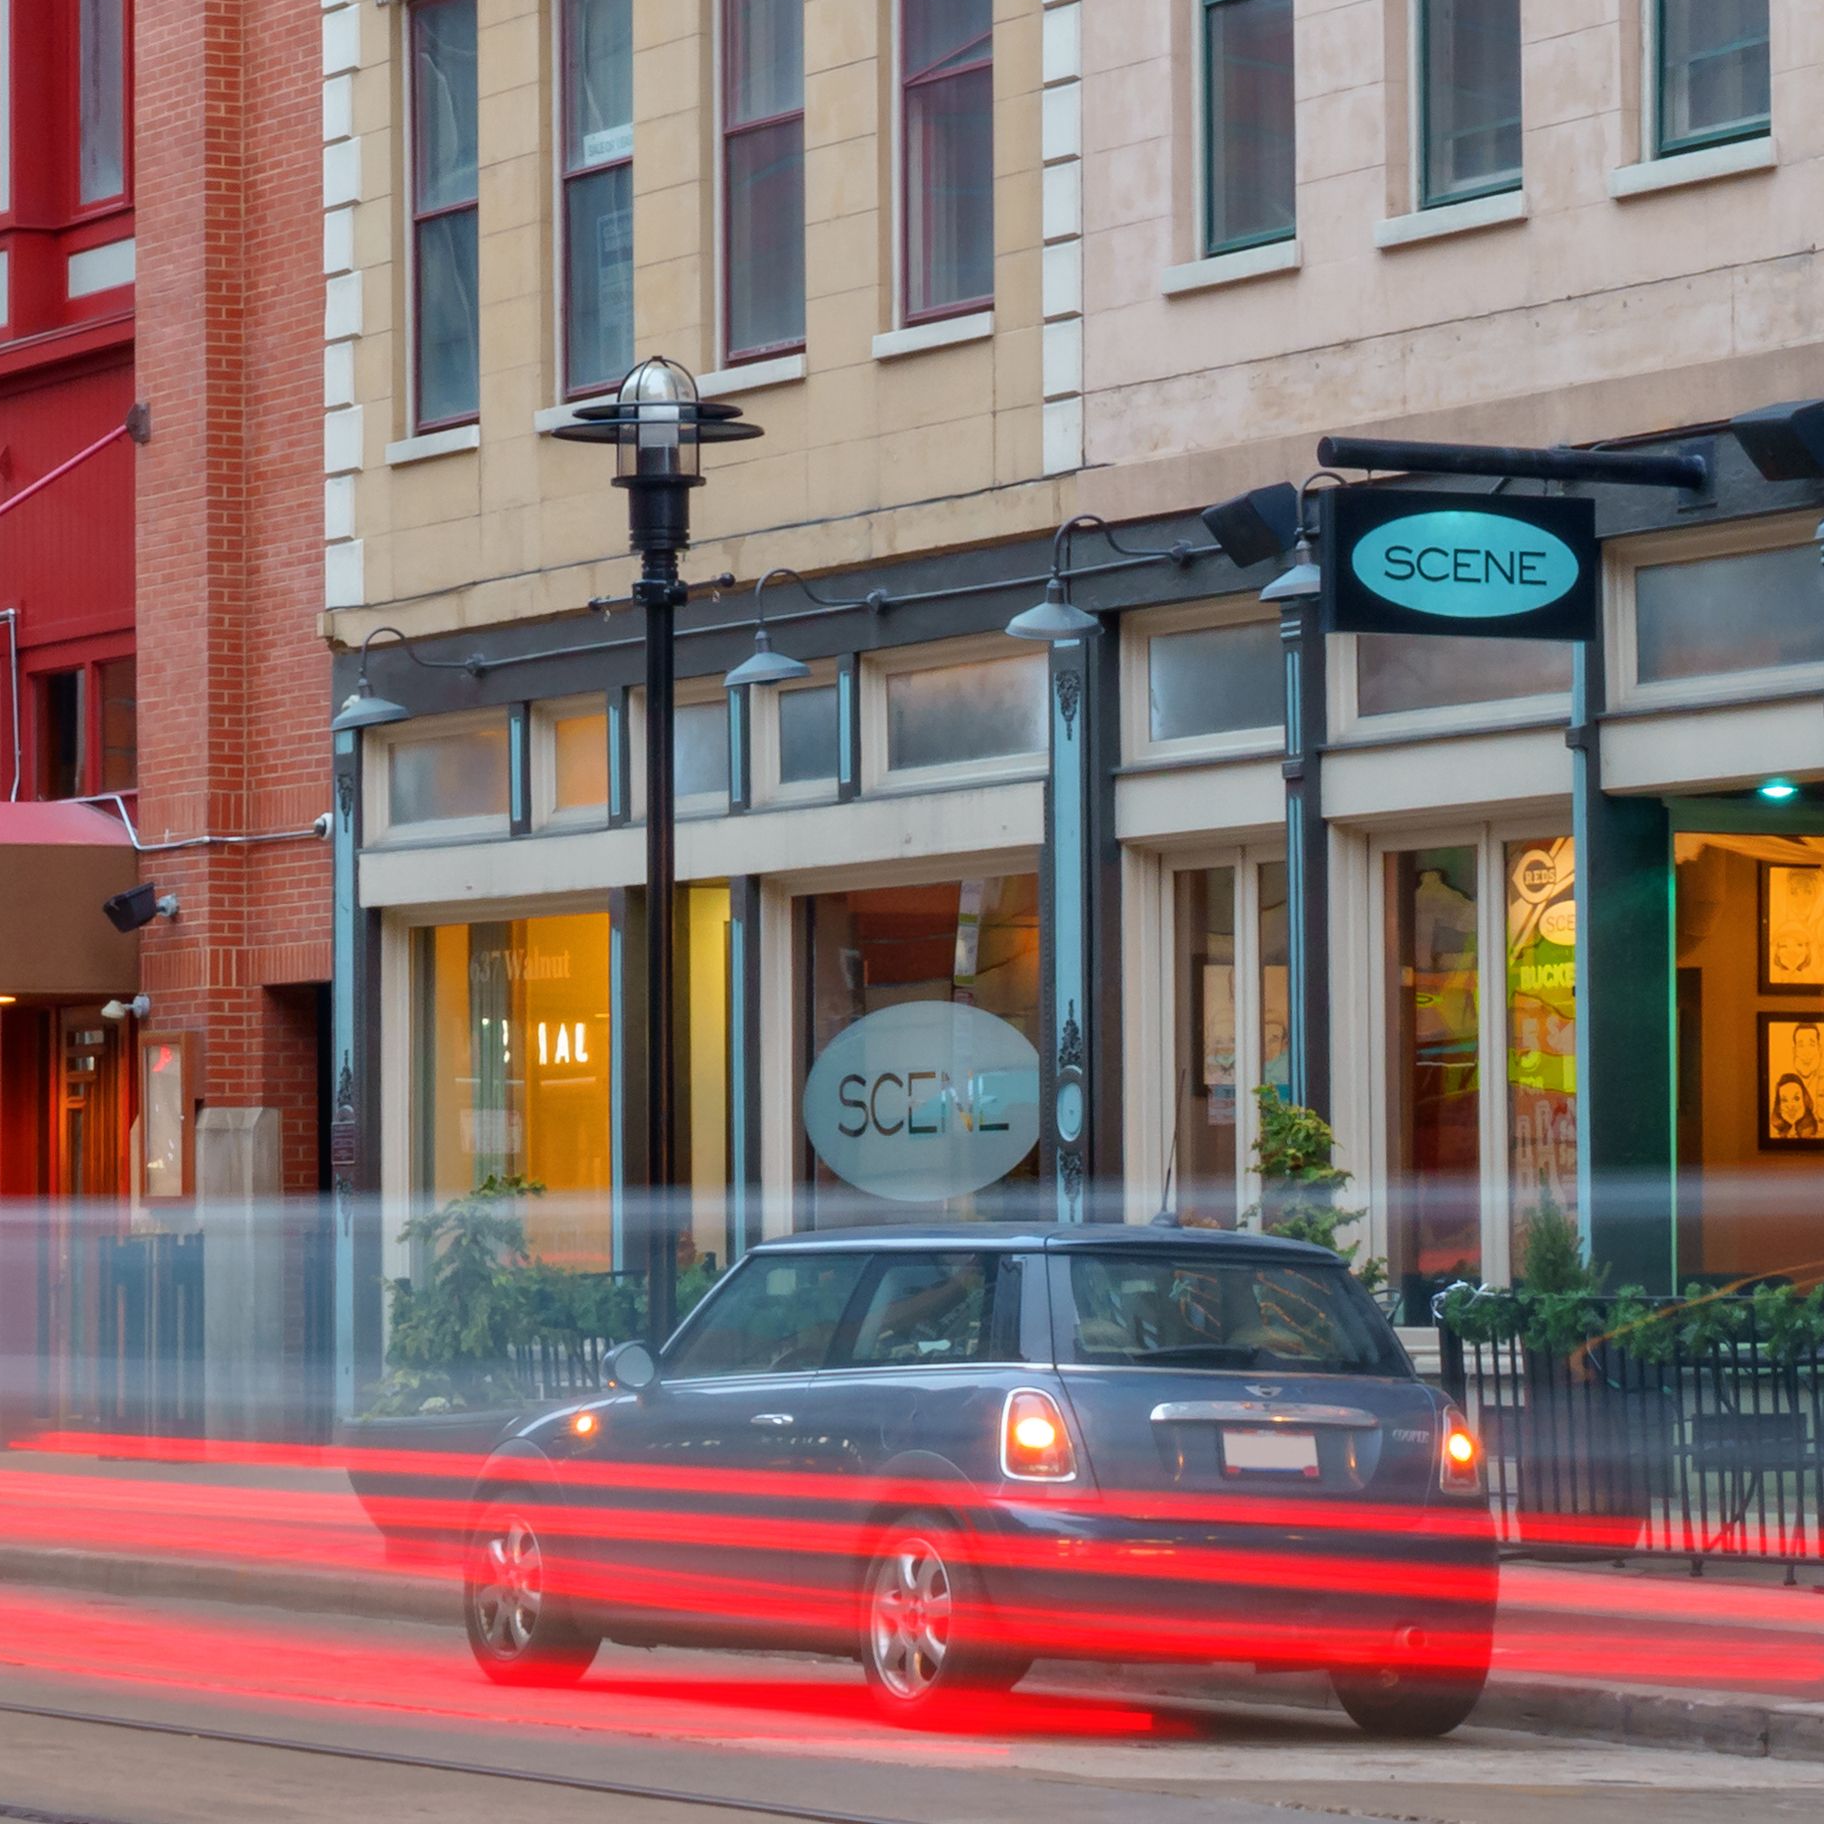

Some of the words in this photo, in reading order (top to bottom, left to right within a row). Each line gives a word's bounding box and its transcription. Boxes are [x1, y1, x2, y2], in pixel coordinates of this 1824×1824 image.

[1384, 545, 1548, 586] SCENE
[1524, 868, 1557, 885] REDS
[502, 945, 571, 981] Walnut
[838, 1072, 1009, 1137] SCENE
